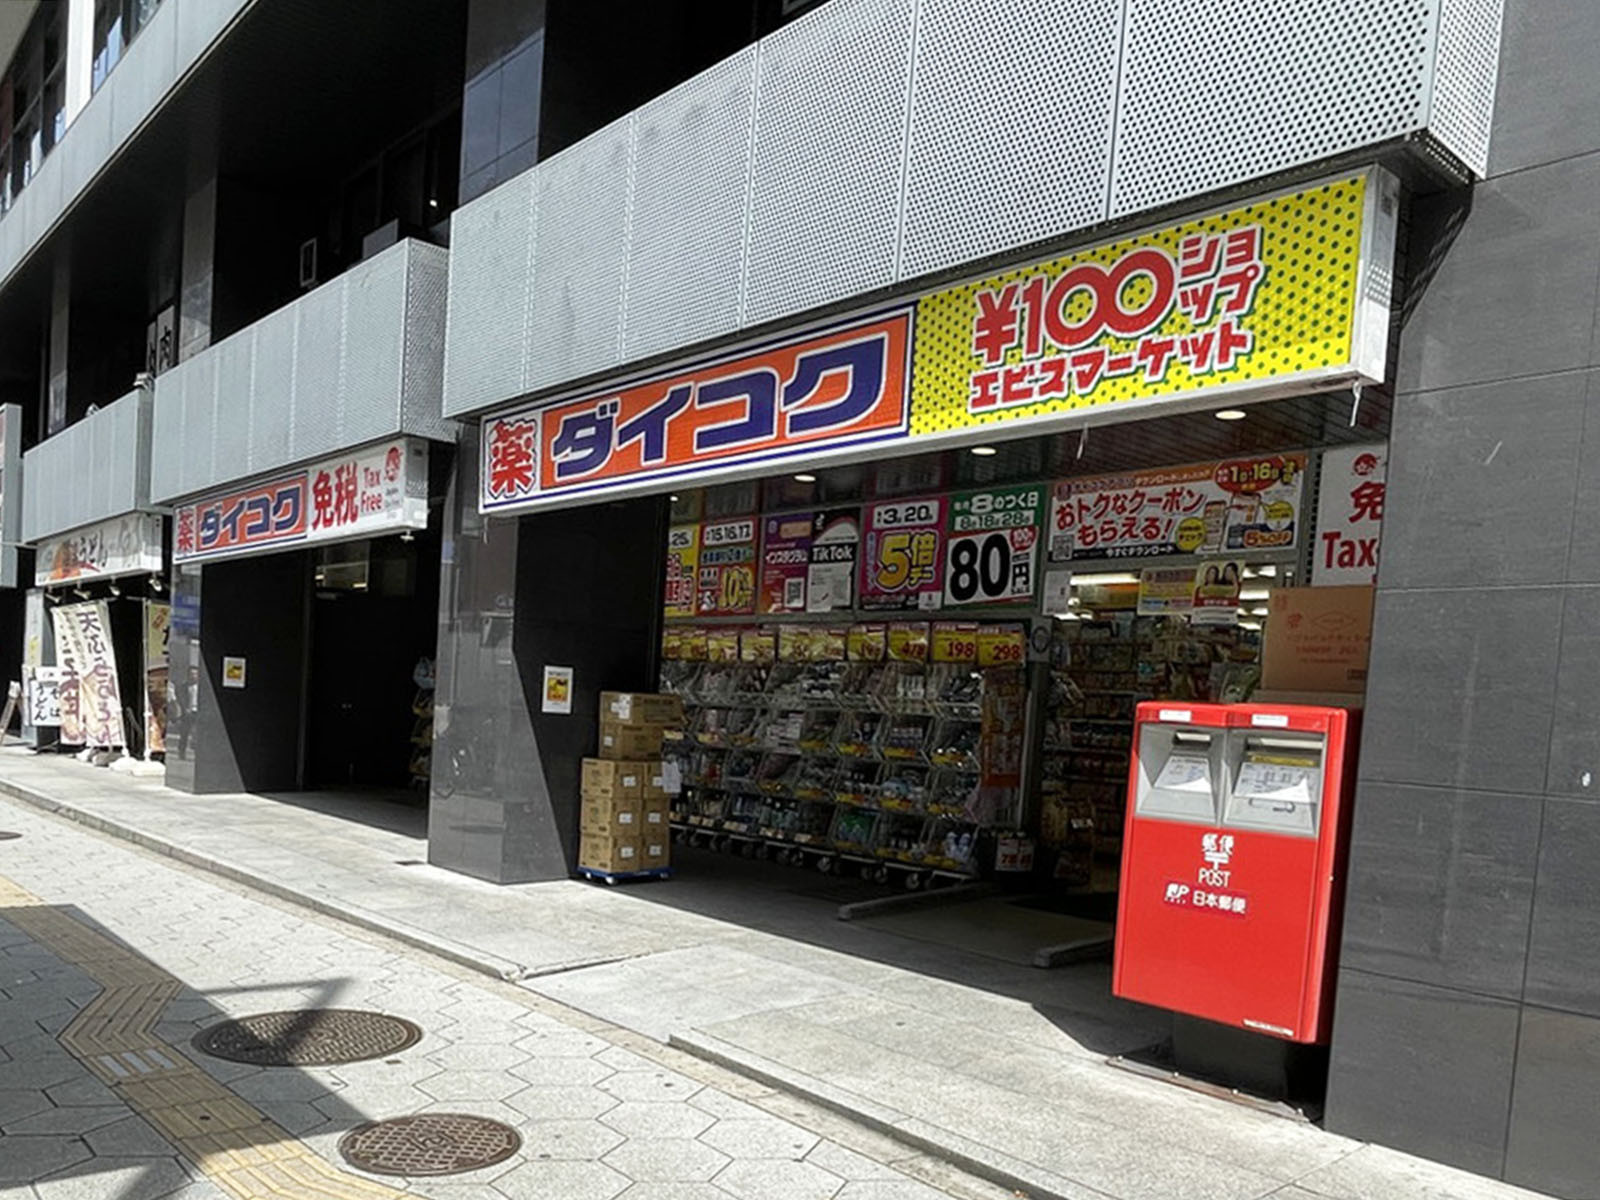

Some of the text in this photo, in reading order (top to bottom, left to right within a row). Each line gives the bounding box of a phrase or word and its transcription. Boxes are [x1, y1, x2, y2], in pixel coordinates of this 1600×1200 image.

[976, 248, 1178, 363] ¥100
[970, 322, 1253, 413] エビスマーケット
[487, 331, 889, 497] 薬 ダイコク
[363, 466, 382, 488] Tax
[311, 460, 358, 531] 免税
[361, 490, 383, 513] Free
[1055, 486, 1205, 531] おトクなクーポン
[200, 485, 301, 547] ダイコク
[1077, 516, 1173, 547] もらえる!
[812, 545, 853, 562] TikTok
[1322, 531, 1377, 569] Tax
[947, 641, 975, 658] 198
[992, 643, 1021, 662] 298
[1198, 867, 1231, 888] POST
[1193, 889, 1246, 915] 日本郵便
